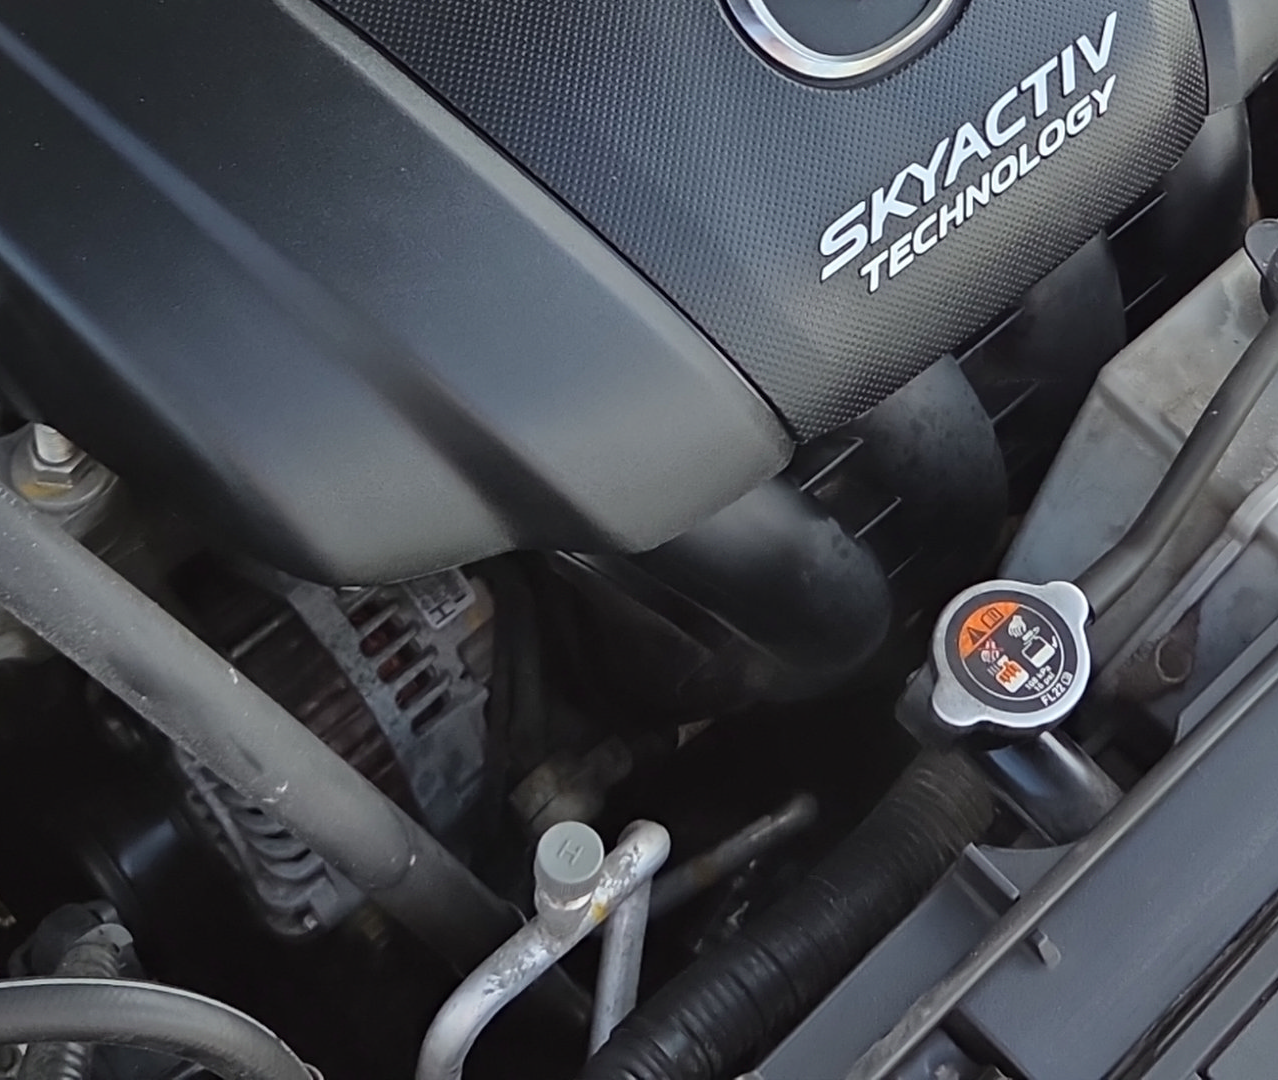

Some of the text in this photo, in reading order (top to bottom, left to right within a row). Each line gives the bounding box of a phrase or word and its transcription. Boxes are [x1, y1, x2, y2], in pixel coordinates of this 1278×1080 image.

[819, 10, 1117, 282] SKYACTIV
[859, 74, 1117, 293] TECHNOLOGY
[1040, 682, 1066, 706] FL22
[556, 837, 583, 867] H
